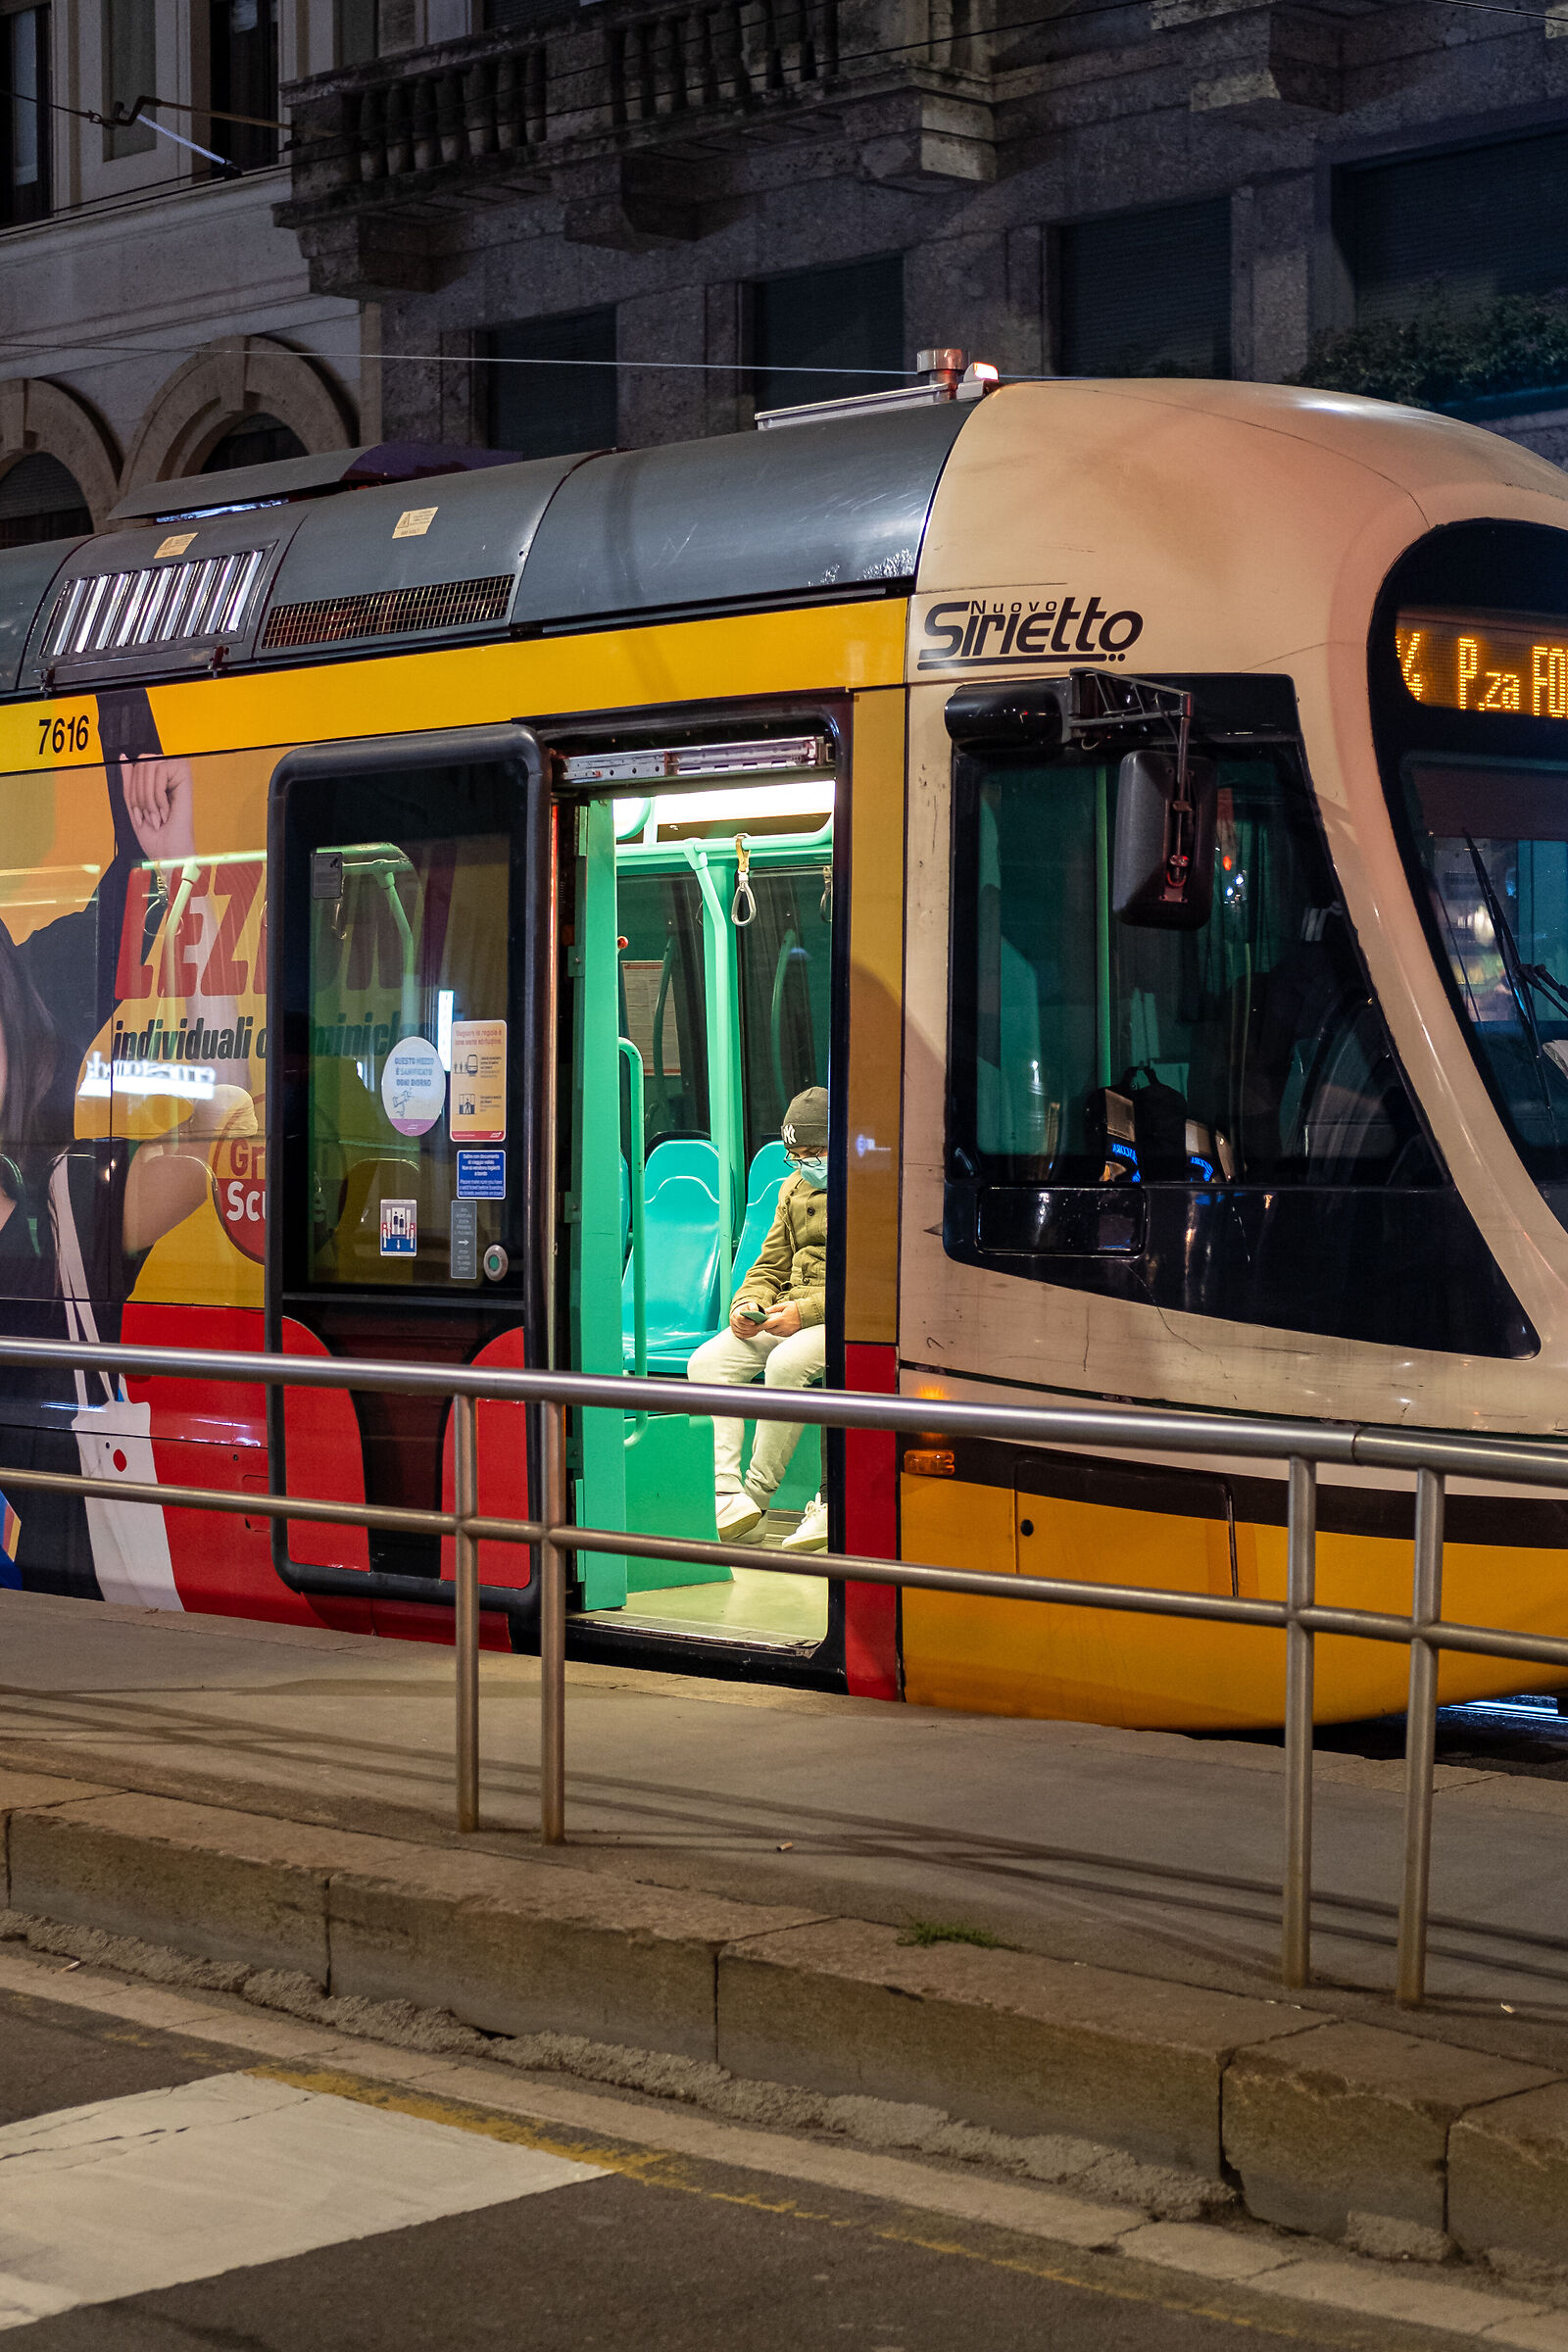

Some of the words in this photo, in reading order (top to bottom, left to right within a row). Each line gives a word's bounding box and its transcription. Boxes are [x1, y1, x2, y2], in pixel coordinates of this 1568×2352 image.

[970, 600, 1057, 614] Nuovo
[1533, 645, 1568, 718] FO
[38, 714, 90, 755] 7616
[113, 1015, 255, 1061] individuali
[229, 1136, 267, 1179] Gr
[225, 1180, 267, 1222] Sc
